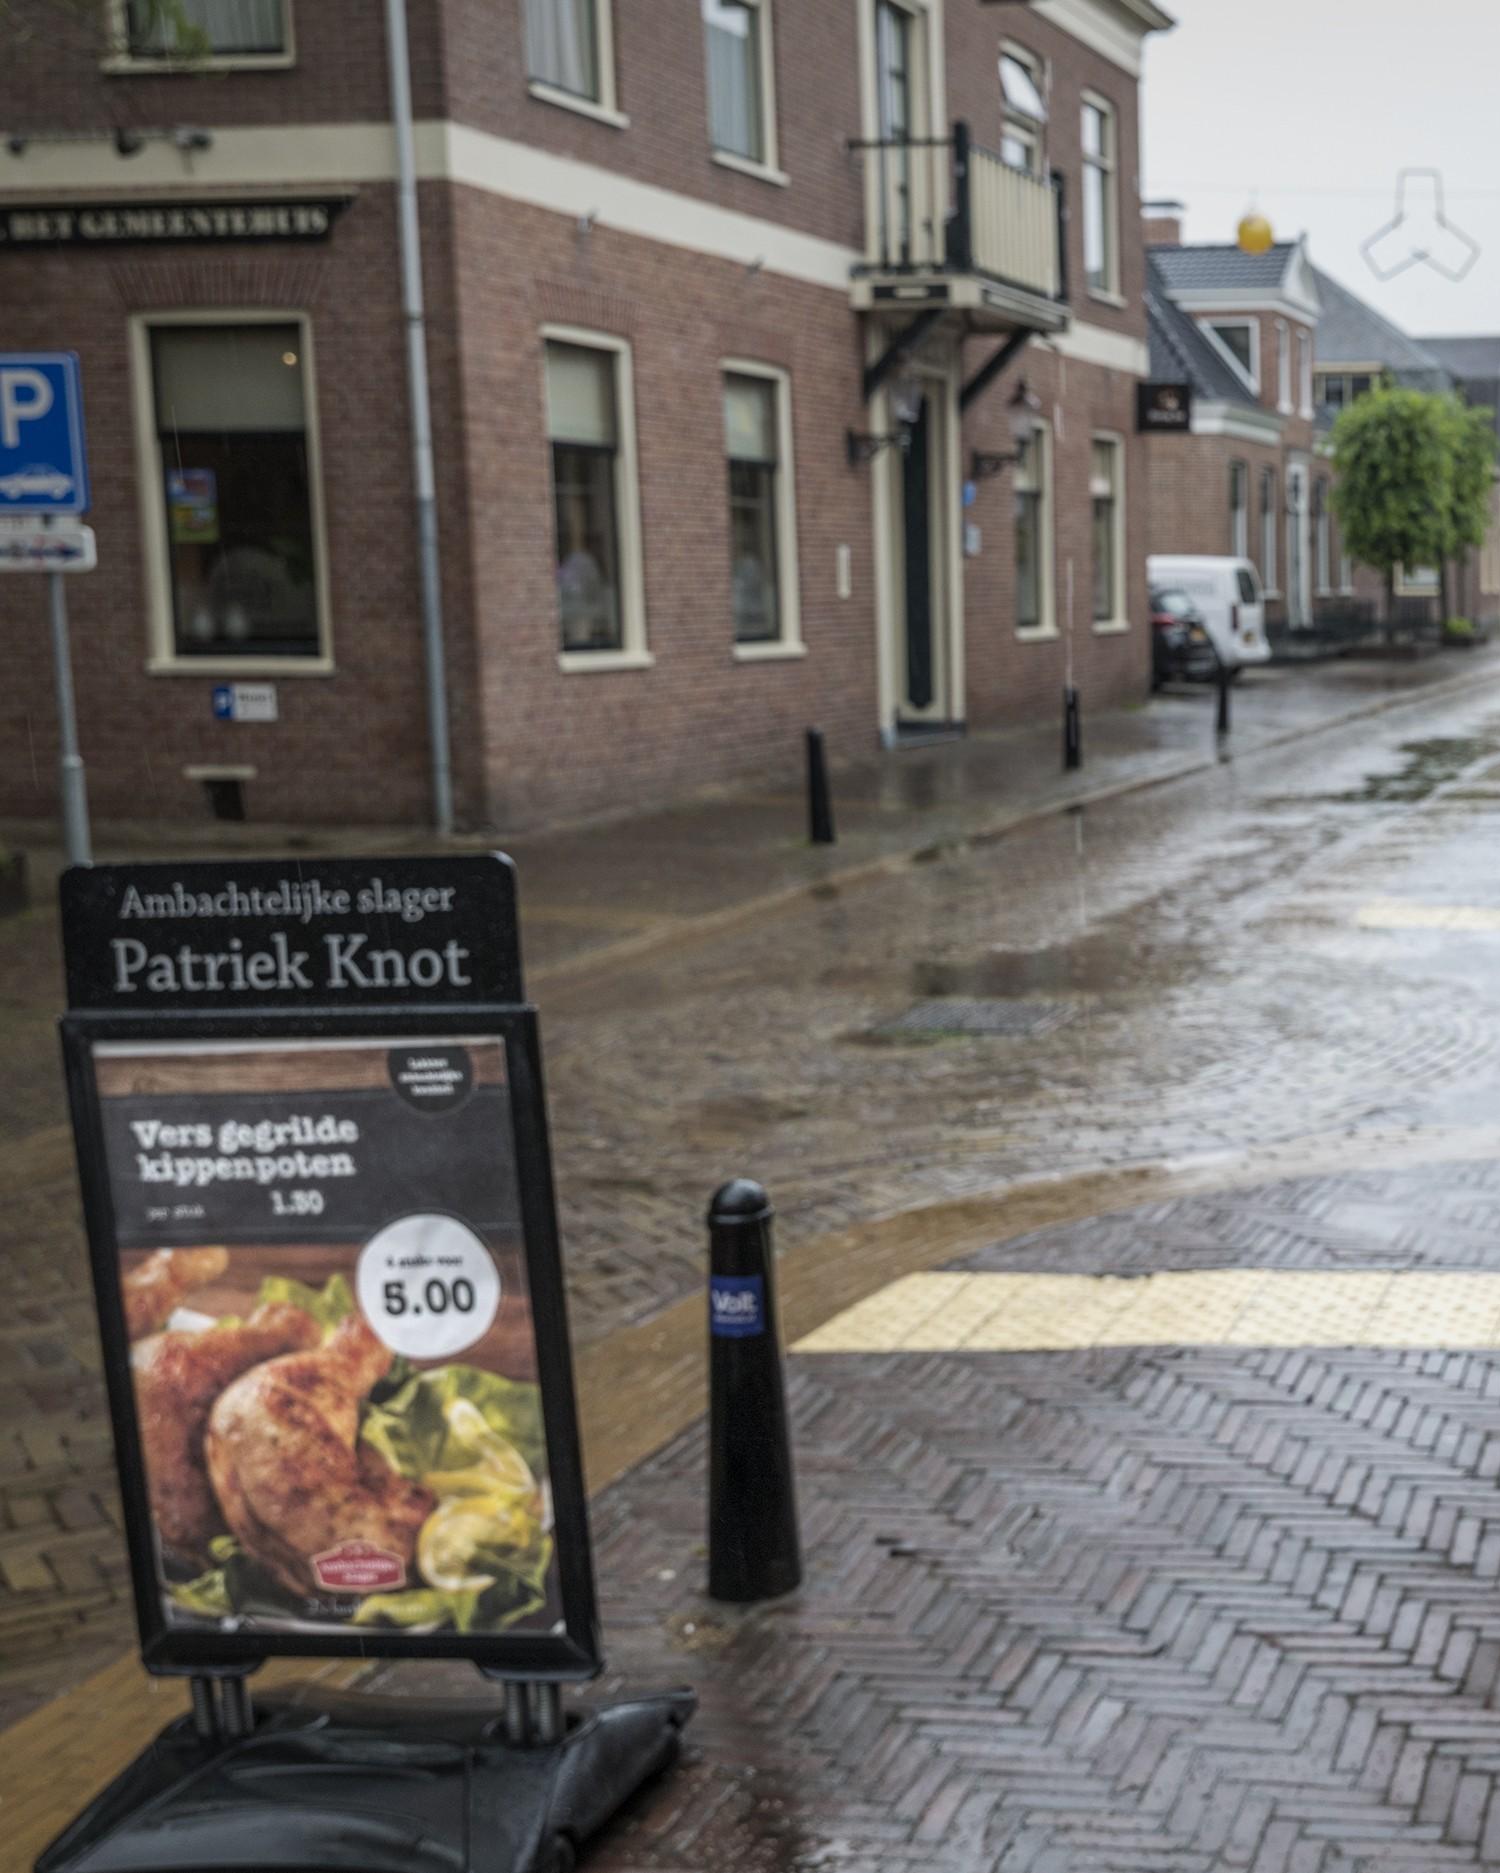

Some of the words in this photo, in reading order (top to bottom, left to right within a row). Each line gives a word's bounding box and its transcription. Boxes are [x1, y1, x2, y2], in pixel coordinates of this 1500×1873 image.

[9, 210, 73, 240] HET
[0, 366, 54, 449] P
[119, 879, 352, 923] Ambachtelijke
[356, 878, 456, 922] slager
[110, 932, 313, 992] Patriek
[324, 933, 472, 990] Knot
[131, 1119, 213, 1150] Vers
[217, 1115, 359, 1154] gegrilde
[136, 1150, 357, 1185] kippenpoten
[383, 1278, 476, 1317] 5.00
